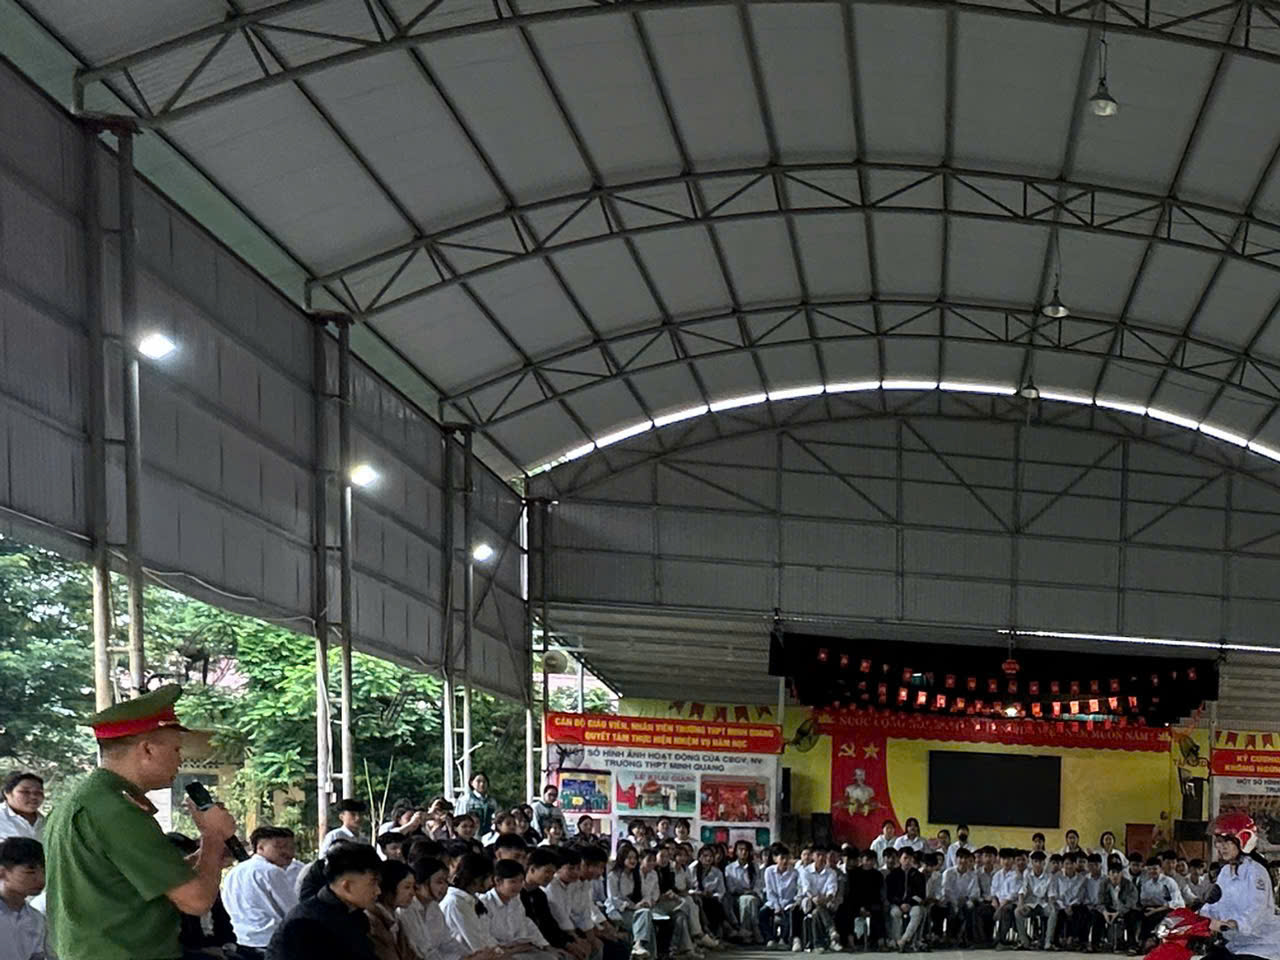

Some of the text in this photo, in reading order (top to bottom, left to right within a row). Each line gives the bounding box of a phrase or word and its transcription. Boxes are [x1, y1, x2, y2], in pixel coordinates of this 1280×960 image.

[555, 716, 573, 726] CÁN
[574, 718, 586, 728] BỘ
[587, 718, 607, 729] GIÁO
[707, 726, 726, 735] THPT
[584, 730, 611, 741] QUYẾT
[612, 732, 630, 742] TÂM
[587, 747, 601, 756] SỐ
[602, 748, 625, 758] HÌNH
[627, 749, 646, 759] ẢNH
[702, 753, 721, 762] CỦA
[604, 758, 725, 772] TRƯỜNG THPT MINH QUANG
